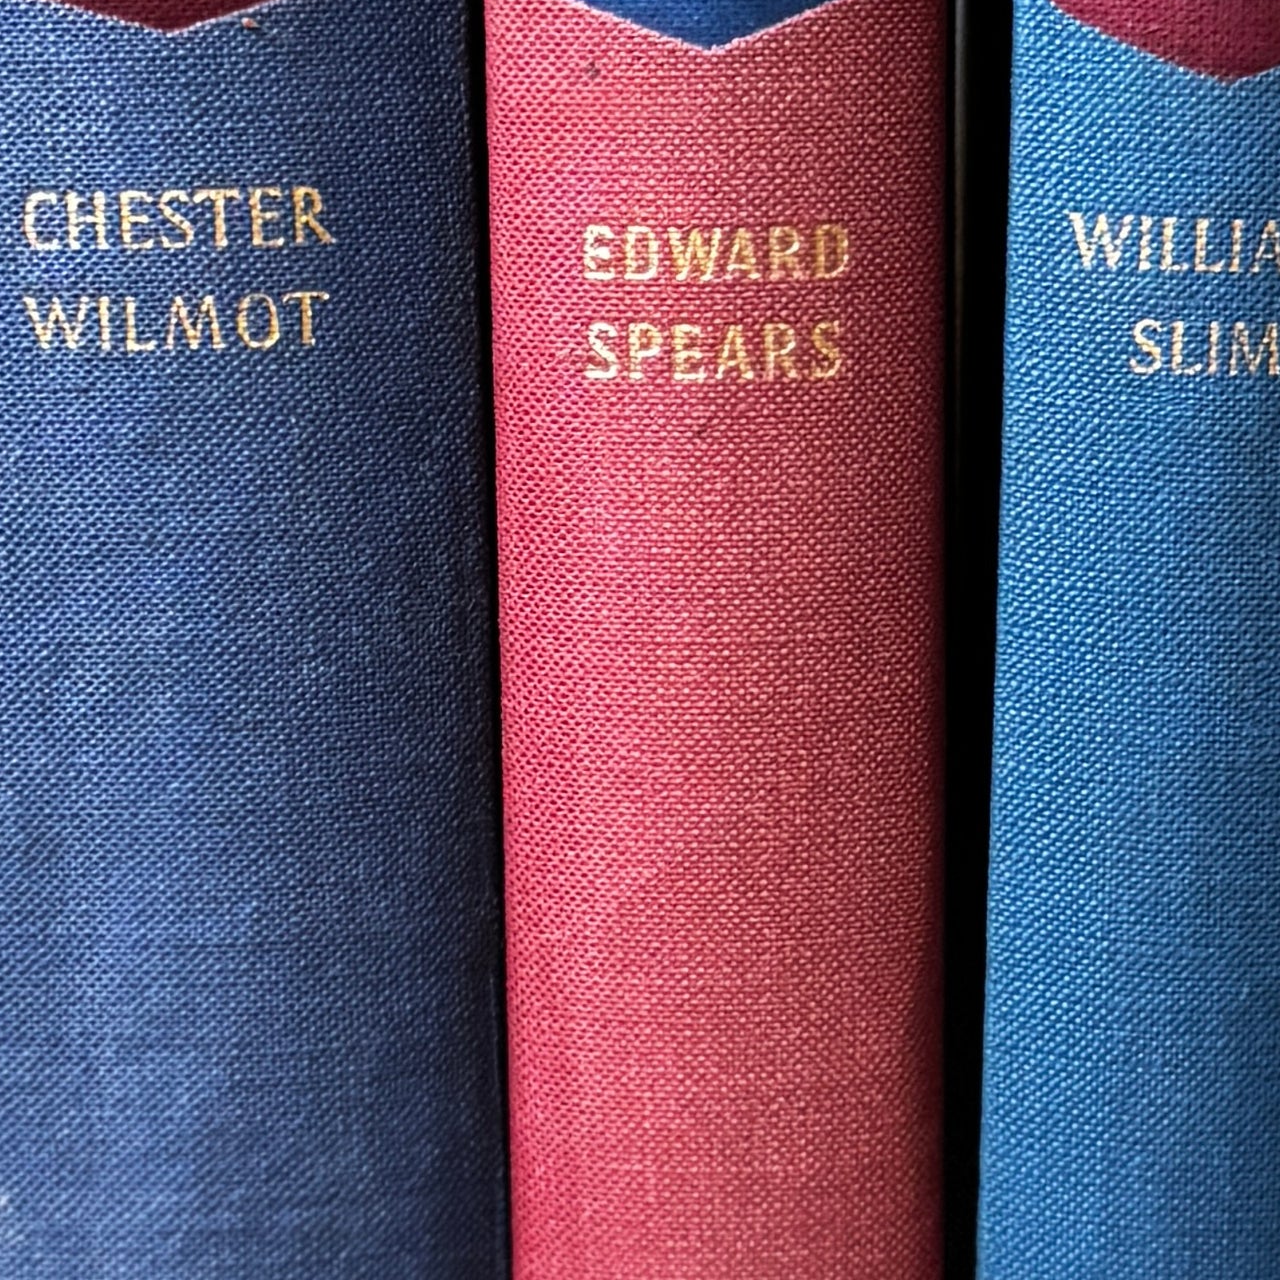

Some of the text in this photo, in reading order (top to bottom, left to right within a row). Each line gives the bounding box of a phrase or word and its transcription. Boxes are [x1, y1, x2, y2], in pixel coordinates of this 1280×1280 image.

[23, 186, 336, 250] CHESTER
[583, 223, 849, 282] EDWARD
[22, 291, 330, 351] WILMOT
[584, 321, 843, 381] SPEARS
[1129, 319, 1280, 376] SLIM
